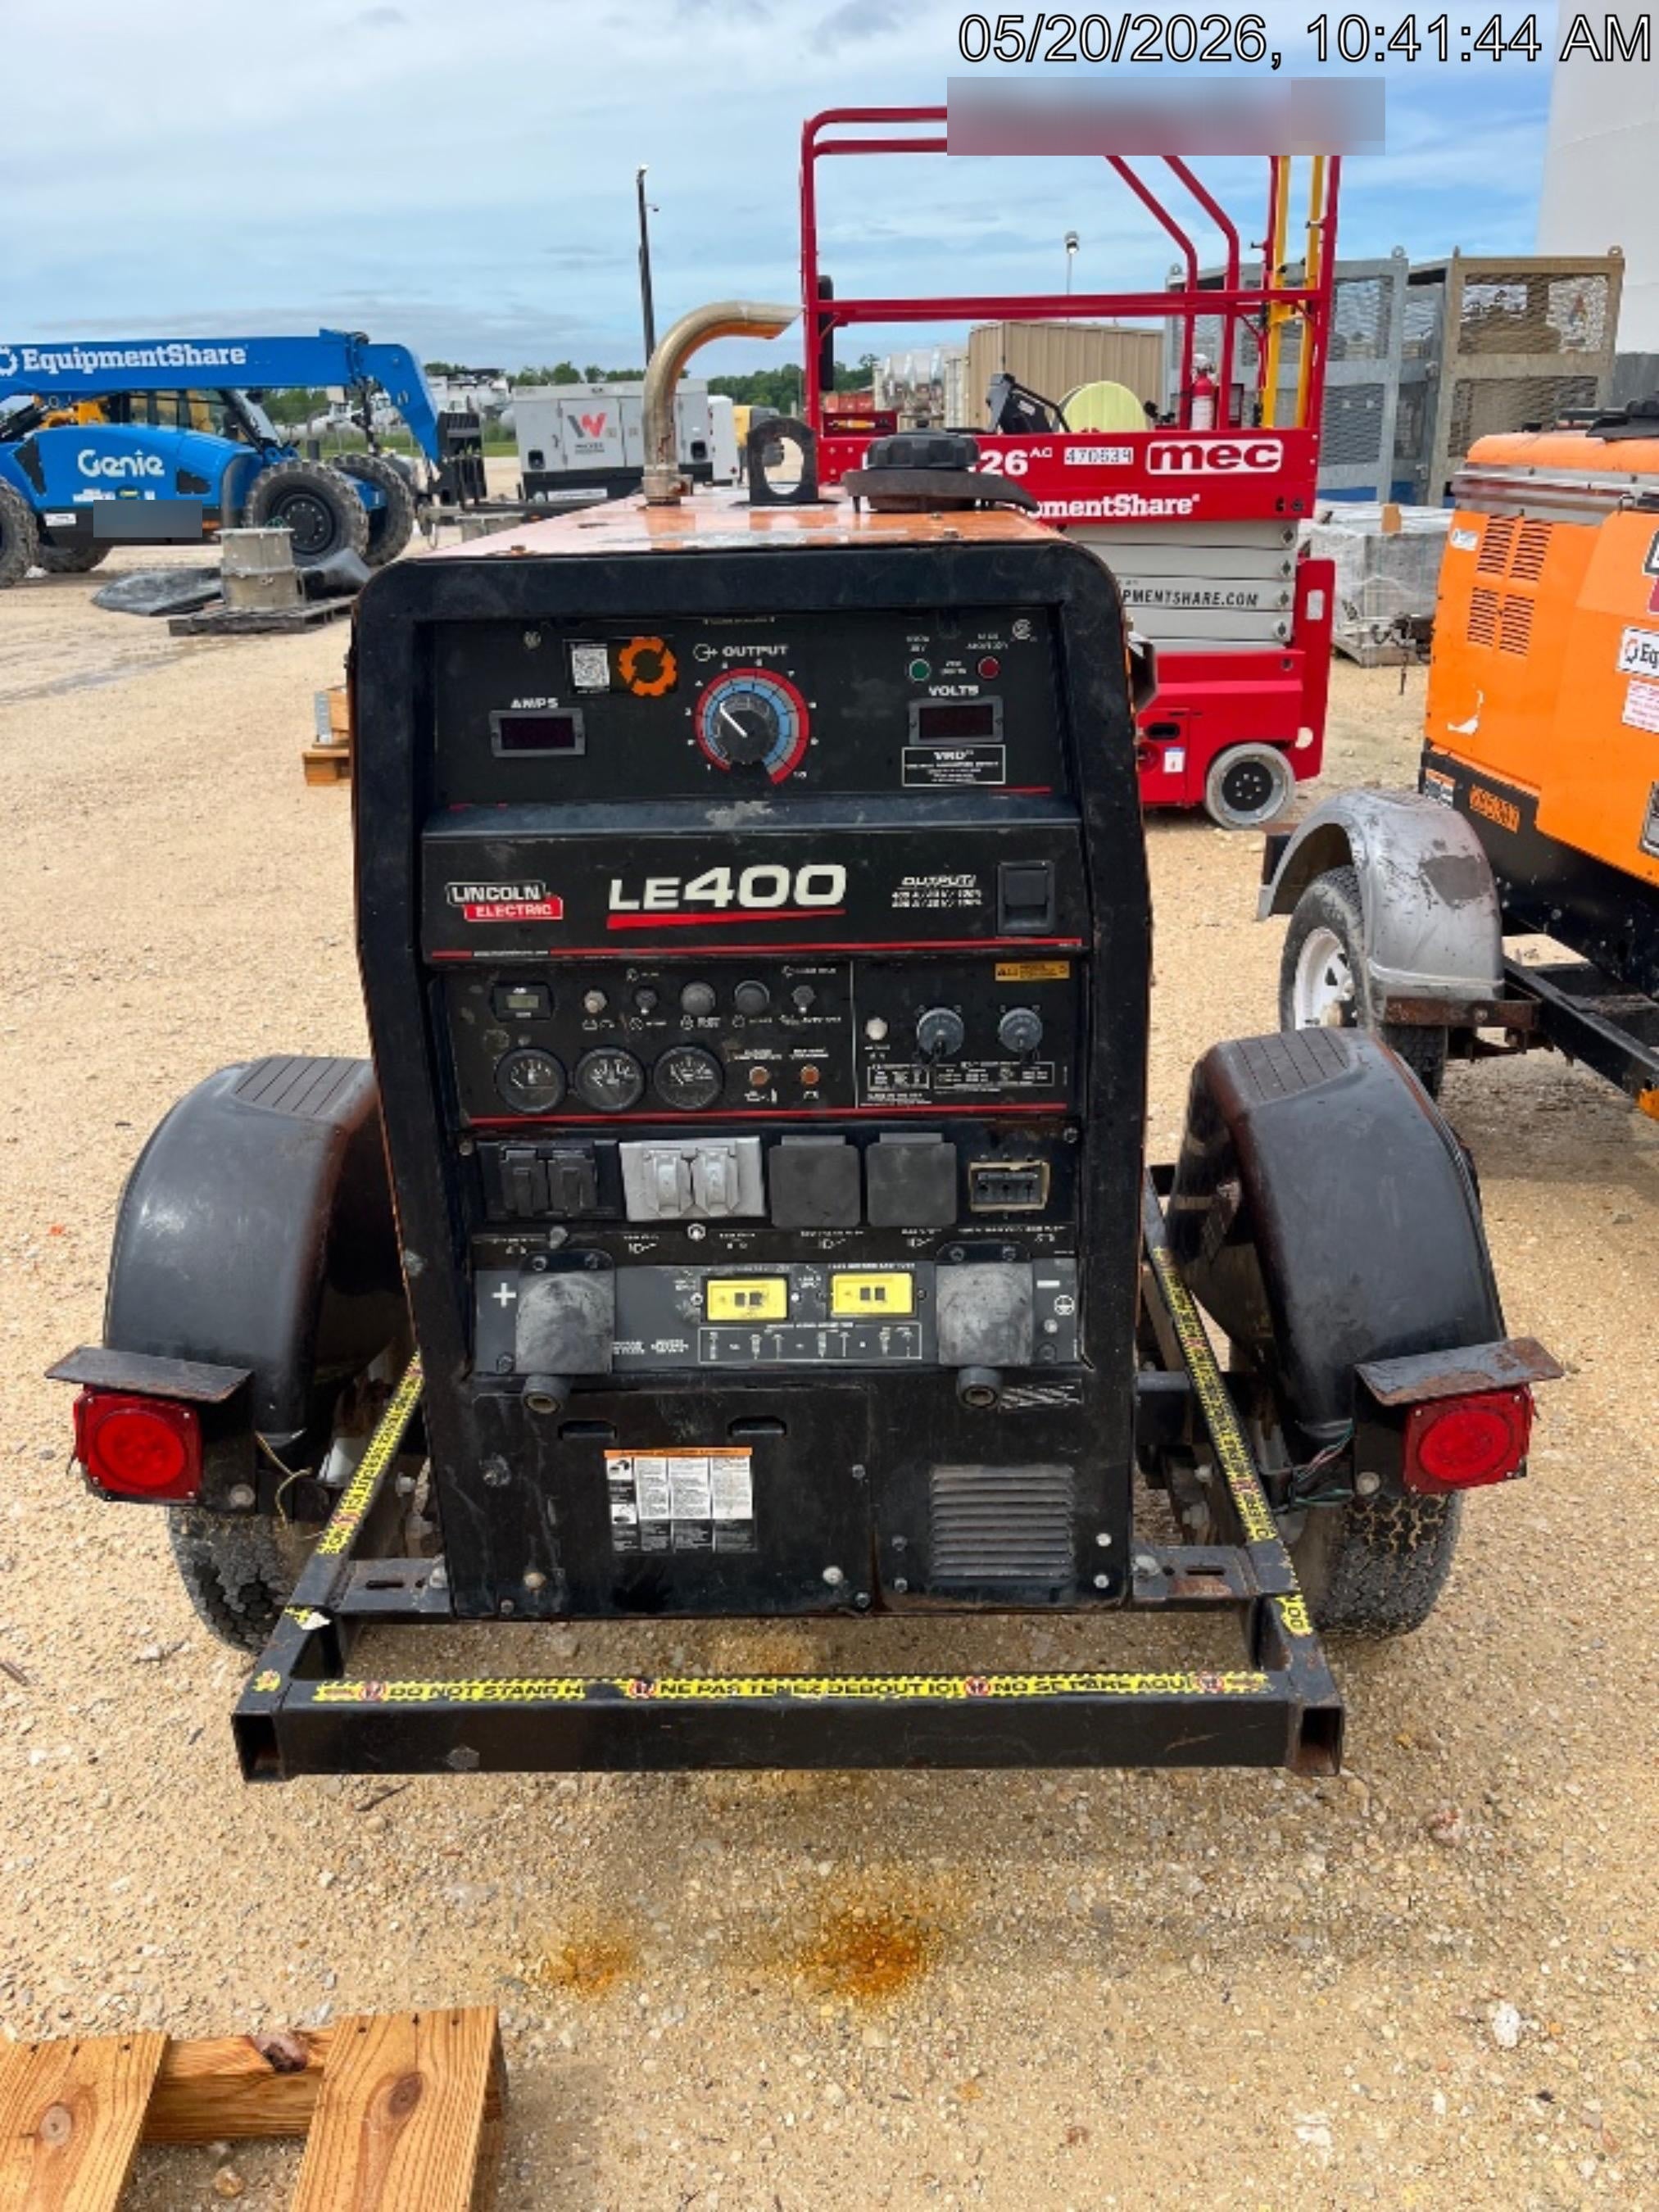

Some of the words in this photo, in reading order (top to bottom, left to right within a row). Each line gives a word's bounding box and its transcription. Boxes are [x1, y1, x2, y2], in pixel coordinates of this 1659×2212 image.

[21, 344, 246, 374] EquipmentShare
[78, 449, 165, 478] Genie
[1149, 443, 1280, 470] mec
[1122, 589, 1259, 606] PMENTSHARE.COM
[722, 646, 788, 656] OUTPUT
[928, 685, 979, 696] VOLTS
[510, 698, 559, 709] AMPS
[452, 886, 541, 903] LINCOLN
[609, 864, 846, 911] LE400
[475, 904, 553, 918] ELECTRIC
[390, 1685, 420, 1696] DO
[428, 1685, 478, 1696] NOT
[483, 1684, 558, 1696] STAND
[995, 1683, 1028, 1693] NO
